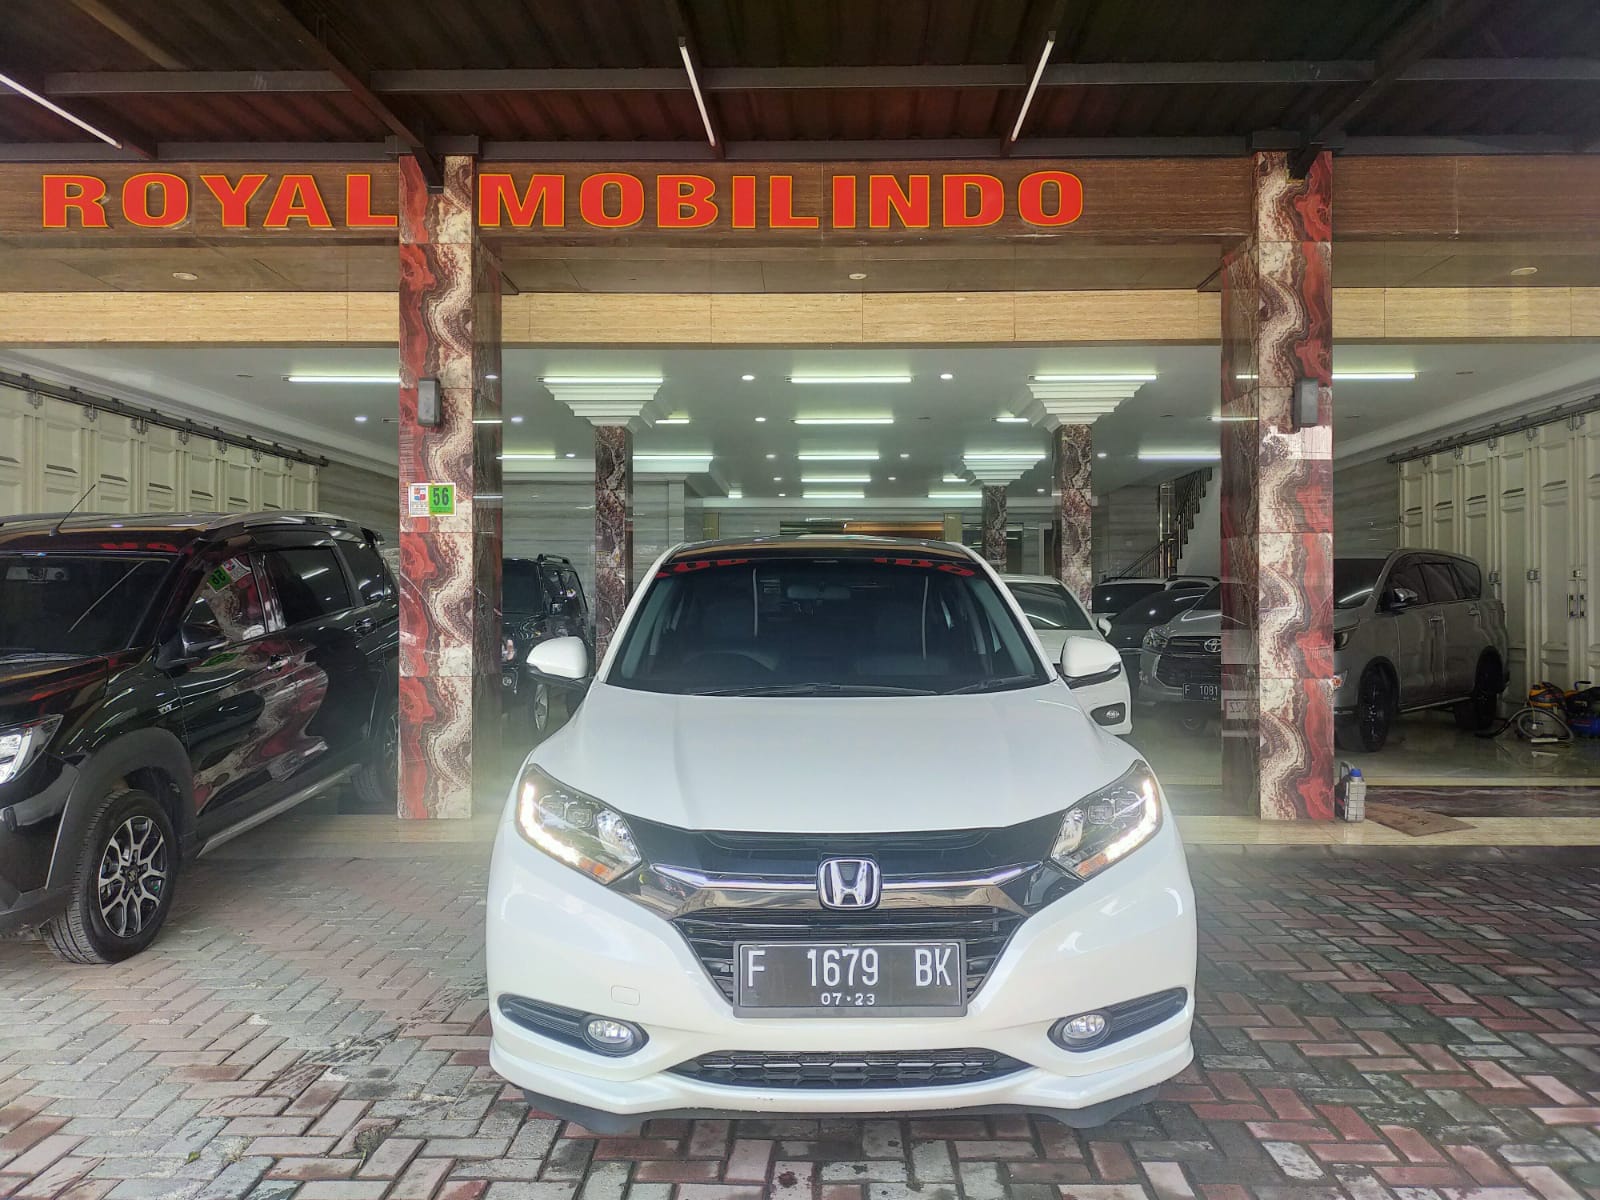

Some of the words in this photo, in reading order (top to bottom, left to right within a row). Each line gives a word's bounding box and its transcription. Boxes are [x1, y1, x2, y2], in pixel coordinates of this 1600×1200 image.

[42, 173, 398, 228] ROYAL
[478, 171, 1084, 229] MOBILINDO
[432, 487, 449, 506] 56
[747, 950, 766, 987] F
[807, 948, 879, 987] 1679
[914, 948, 952, 987] BK
